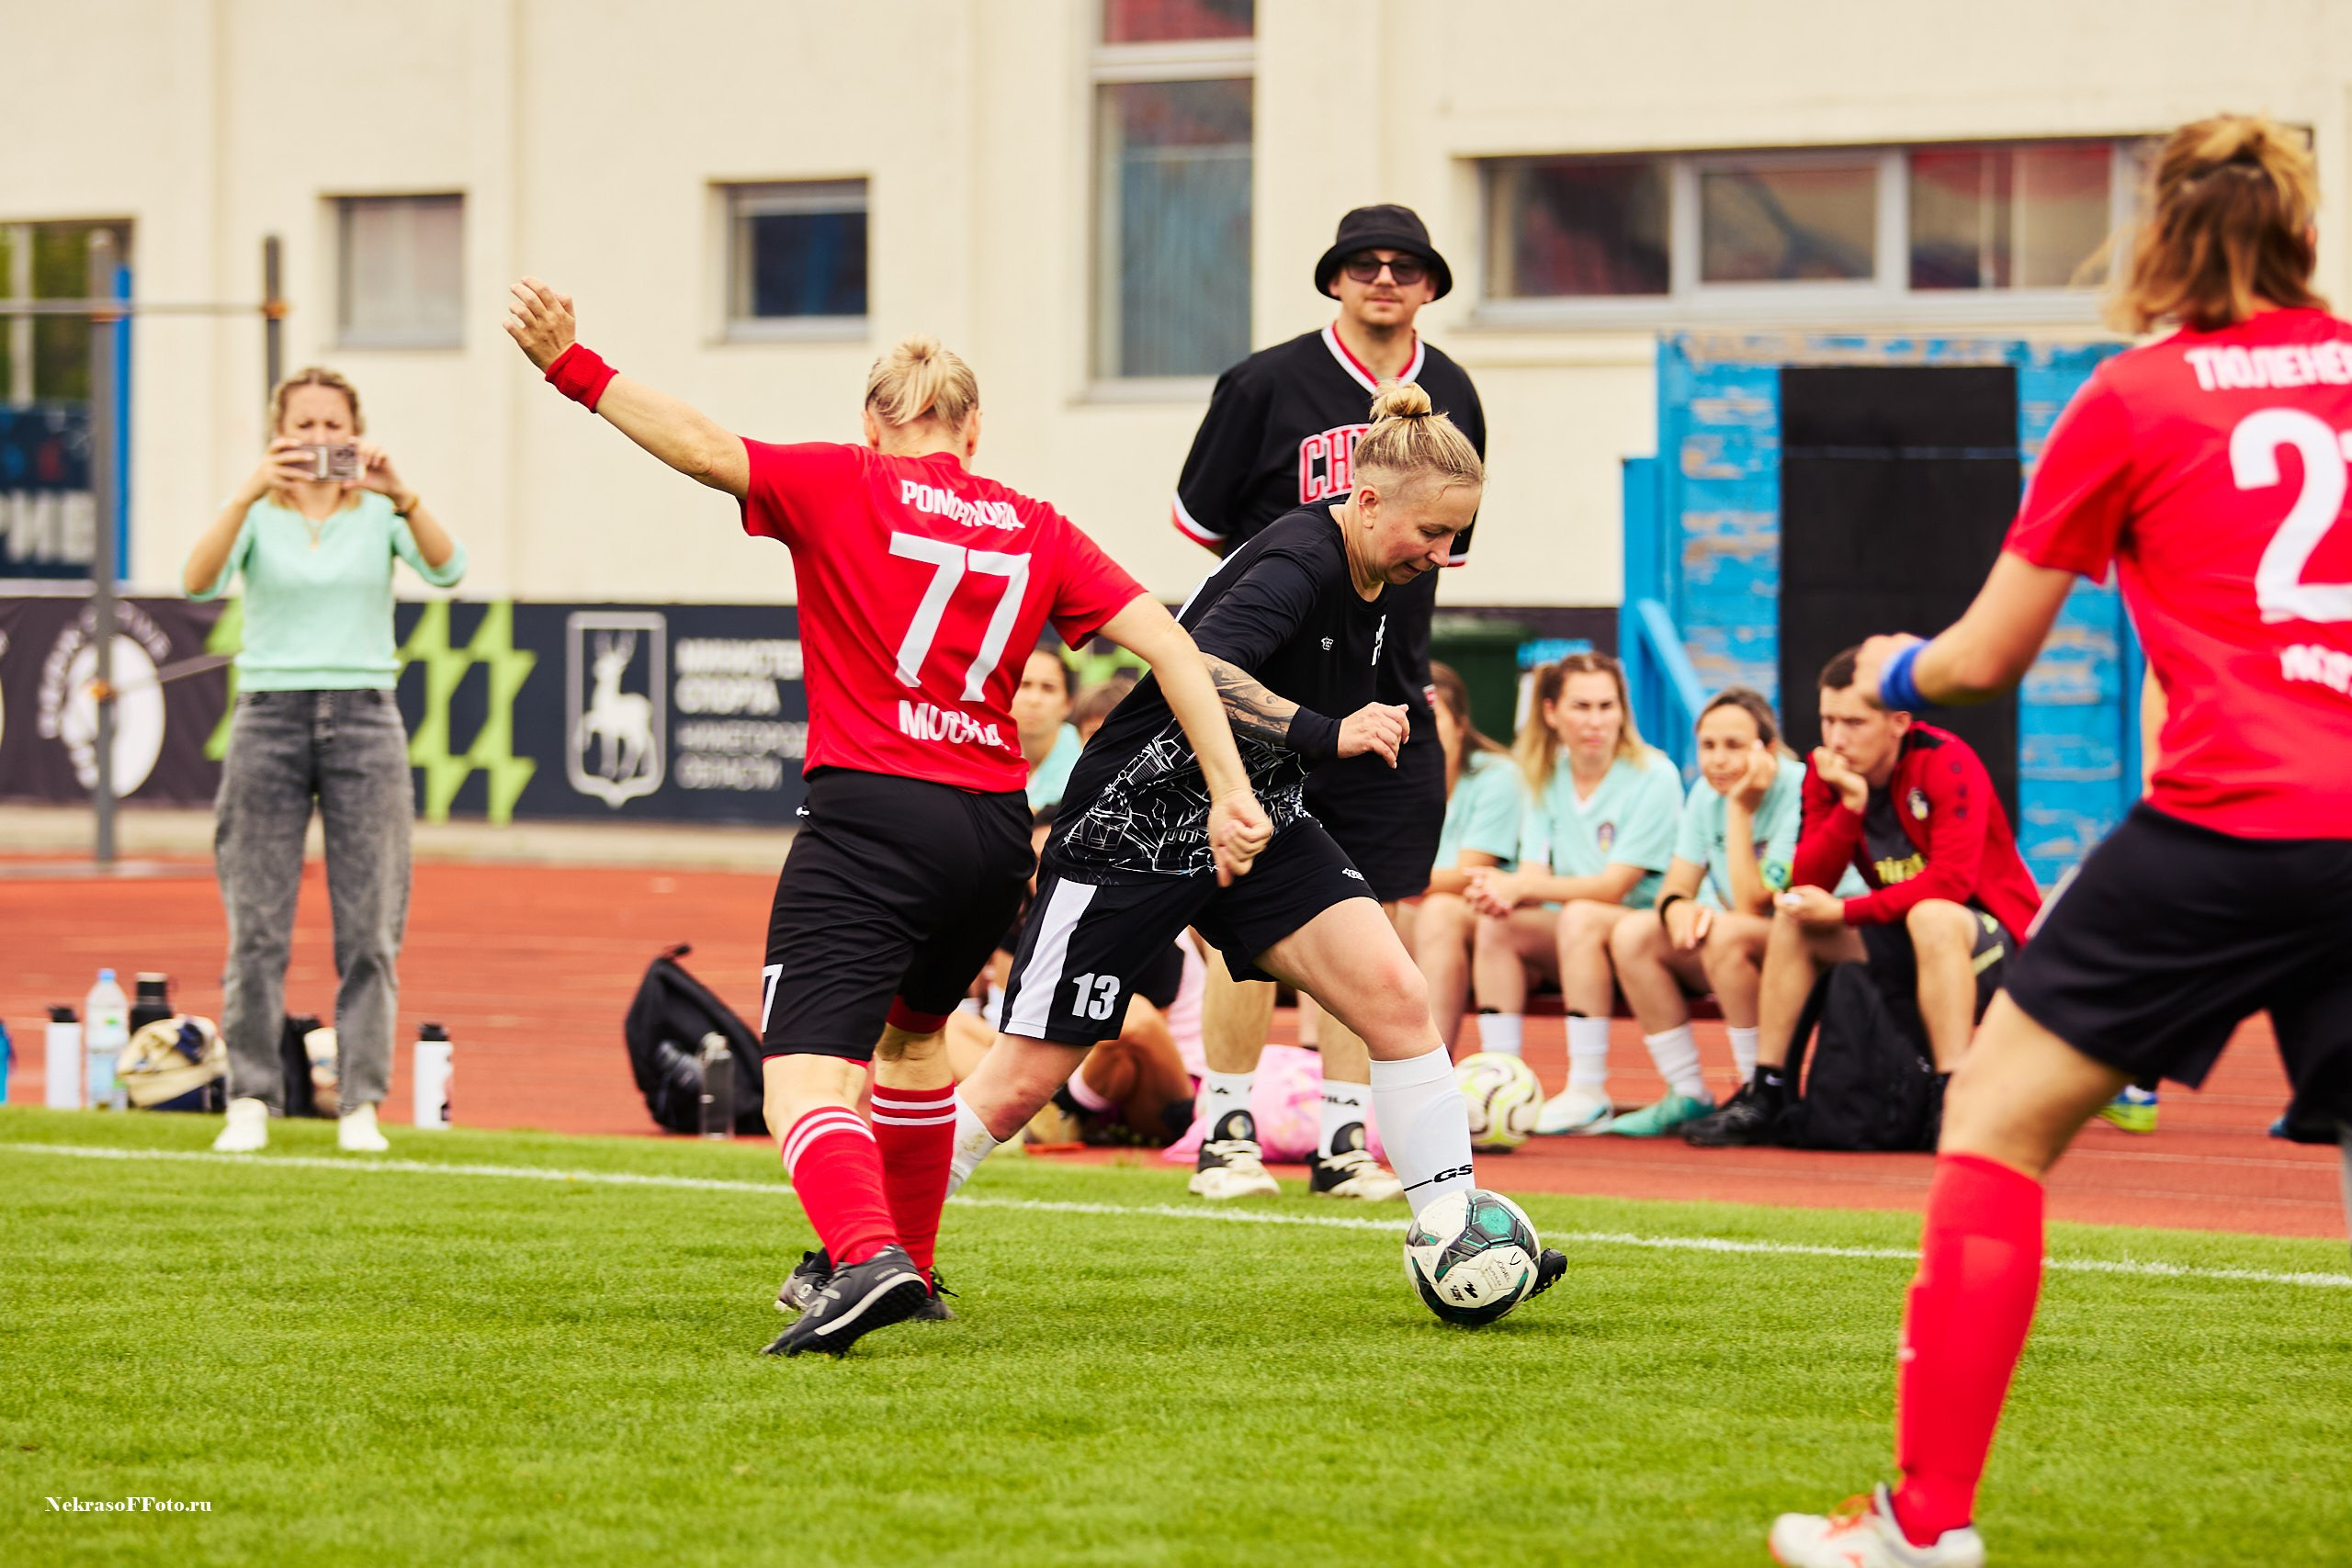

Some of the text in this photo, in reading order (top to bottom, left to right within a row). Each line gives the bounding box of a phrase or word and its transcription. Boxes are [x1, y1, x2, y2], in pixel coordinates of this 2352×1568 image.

[2229, 408, 2352, 624] 2
[888, 531, 1032, 702] 77
[1071, 972, 1120, 1021] 13
